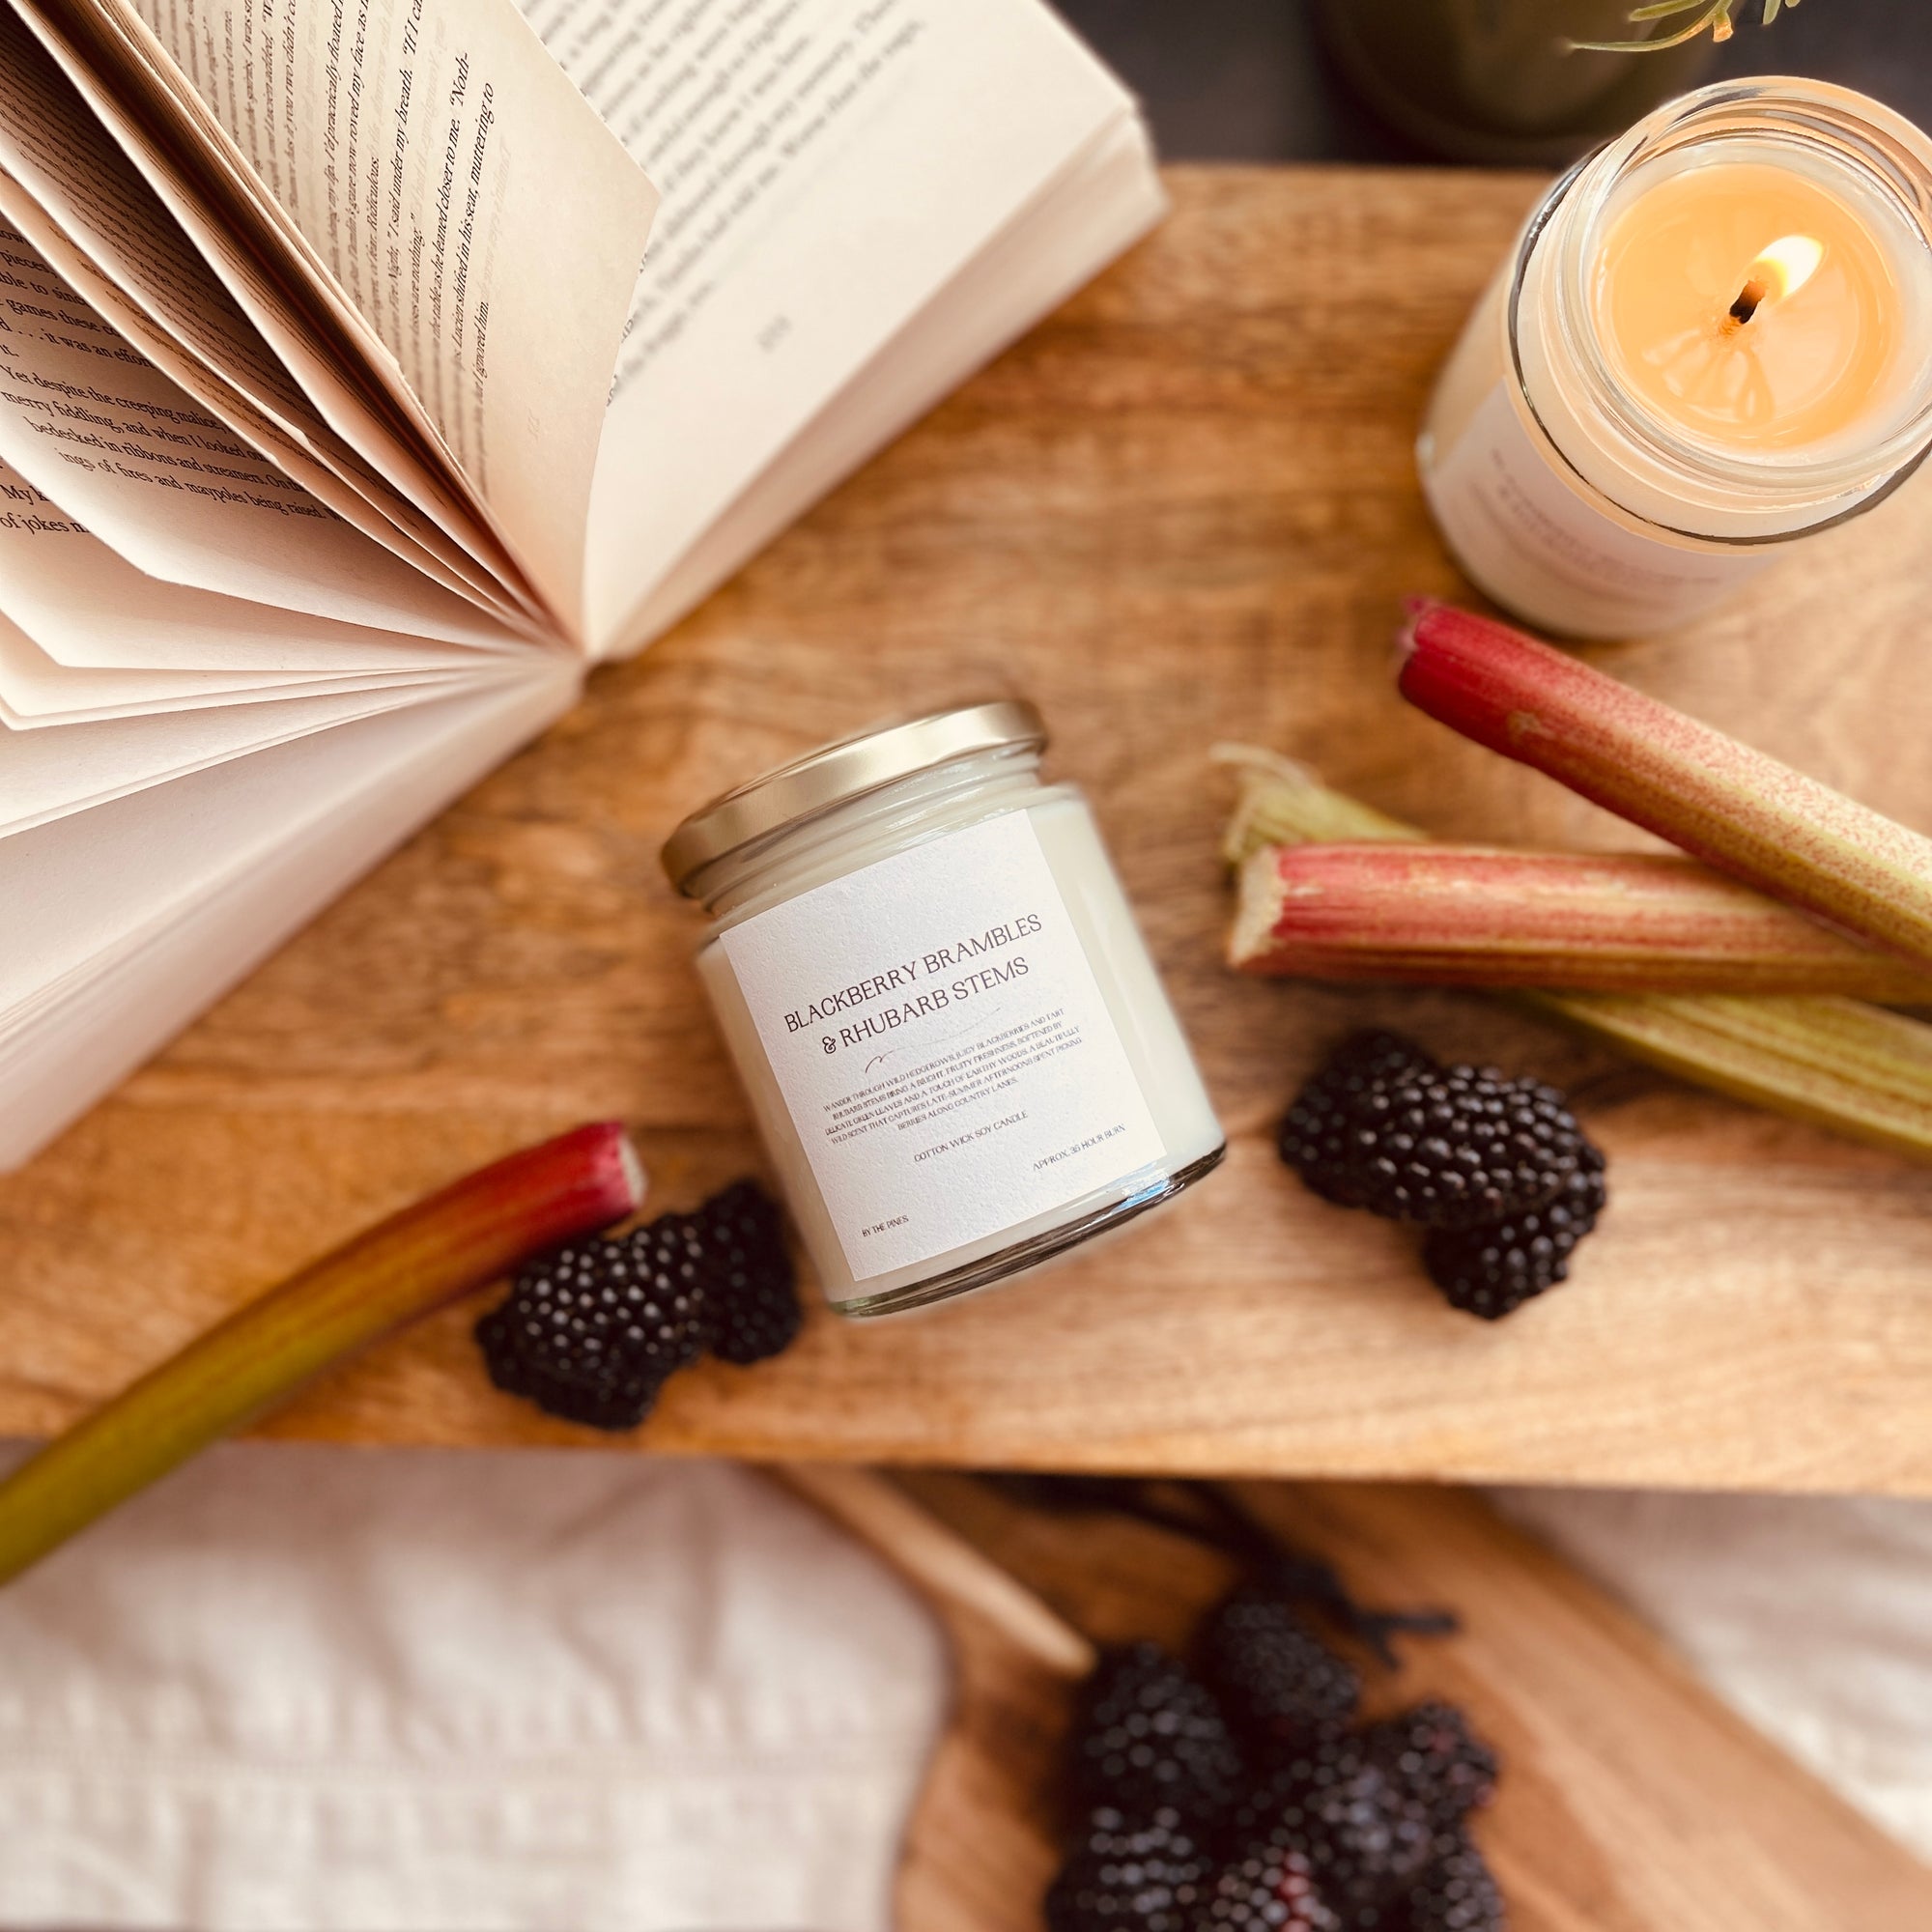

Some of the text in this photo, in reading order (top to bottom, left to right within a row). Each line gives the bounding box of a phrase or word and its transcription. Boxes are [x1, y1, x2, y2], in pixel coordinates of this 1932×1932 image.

[327, 1, 343, 63] floated
[358, 10, 366, 31] as
[408, 17, 417, 35] I
[226, 37, 233, 58] on
[351, 32, 364, 68] face
[262, 31, 274, 131] Lucien added,
[352, 68, 364, 97] my
[395, 69, 412, 126] breath.
[286, 97, 297, 130] you
[326, 60, 341, 145] practically
[348, 91, 359, 143] roved
[394, 124, 409, 153] my
[448, 119, 460, 147] me.
[349, 142, 357, 176] now
[390, 151, 403, 196] under
[446, 147, 455, 165] to
[328, 183, 339, 208] my
[348, 176, 359, 213] gaze
[366, 156, 379, 231] Ridiculous.
[436, 163, 453, 209] closer
[388, 191, 400, 223] said
[452, 83, 495, 348] Lucien shifted in his seat, muttering to
[388, 224, 398, 237] I
[433, 203, 447, 257] leaned
[431, 254, 443, 274] he
[434, 271, 442, 289] as
[30, 282, 48, 295] to
[429, 286, 440, 320] table
[6, 299, 58, 321] games
[58, 310, 100, 332] these
[429, 319, 440, 339] the
[474, 301, 489, 330] him.
[58, 336, 92, 353] was
[92, 345, 113, 358] an
[472, 328, 487, 378] ignored
[473, 372, 483, 384] I
[0, 365, 227, 434] Yet despite the creeping malice,
[0, 391, 54, 416] merry
[53, 401, 124, 433] fiddling,
[123, 422, 152, 437] and
[152, 426, 192, 445] when
[188, 435, 201, 448] I
[197, 436, 246, 458] looked
[23, 416, 105, 448] bedecked
[101, 437, 123, 453] in
[122, 442, 178, 466] ribbons
[176, 457, 205, 471] and
[203, 464, 268, 485] streamers.
[266, 474, 290, 489] On
[0, 485, 34, 505] My
[54, 447, 96, 471] ings
[98, 460, 117, 473] of
[115, 463, 154, 482] fires
[155, 475, 184, 490] and
[185, 483, 247, 503] maypoles
[243, 491, 289, 516] being
[287, 501, 327, 519] raised.
[0, 512, 21, 528] of
[17, 515, 70, 534] jokes
[784, 914, 1042, 1032] BLACKBERRY BRAMBLES
[820, 955, 1029, 1055] & RHUBARB STEMS
[823, 1096, 851, 1112] WANDER
[851, 1082, 886, 1100] THROUGH
[886, 1074, 905, 1087] WILD
[977, 1023, 1030, 1049] BLACKBERRIES
[1030, 1016, 1046, 1027] AND
[825, 1120, 852, 1135] DELICATE
[853, 1111, 874, 1124] GREEN
[875, 1100, 903, 1115] LEAVES
[903, 1094, 920, 1104] AND
[928, 1079, 954, 1094] TOUCH
[955, 1074, 965, 1083] OF
[966, 1062, 997, 1078] EARTHY
[832, 1133, 848, 1144] WILD
[848, 1125, 867, 1138] SCENT
[868, 1118, 887, 1129] THAT
[888, 1102, 926, 1122] CAPTURES
[983, 1058, 1033, 1083] AFTERNOONS
[1033, 1048, 1055, 1062] SPENT
[1056, 1037, 1082, 1052] PICKING
[833, 1103, 863, 1120] RHUBARB
[863, 1094, 887, 1108] STEMS
[946, 1058, 973, 1074] FRUITY
[897, 1114, 926, 1130] BERRIES
[927, 1102, 954, 1118] ALONG
[954, 1088, 991, 1107] COUNTRY
[914, 1111, 1028, 1162] COTTON WICK SOY CANDLE
[1081, 1134, 1103, 1150] HOUR
[1104, 1124, 1125, 1139] BURN
[862, 1228, 871, 1237] BY
[872, 1223, 886, 1234] THE
